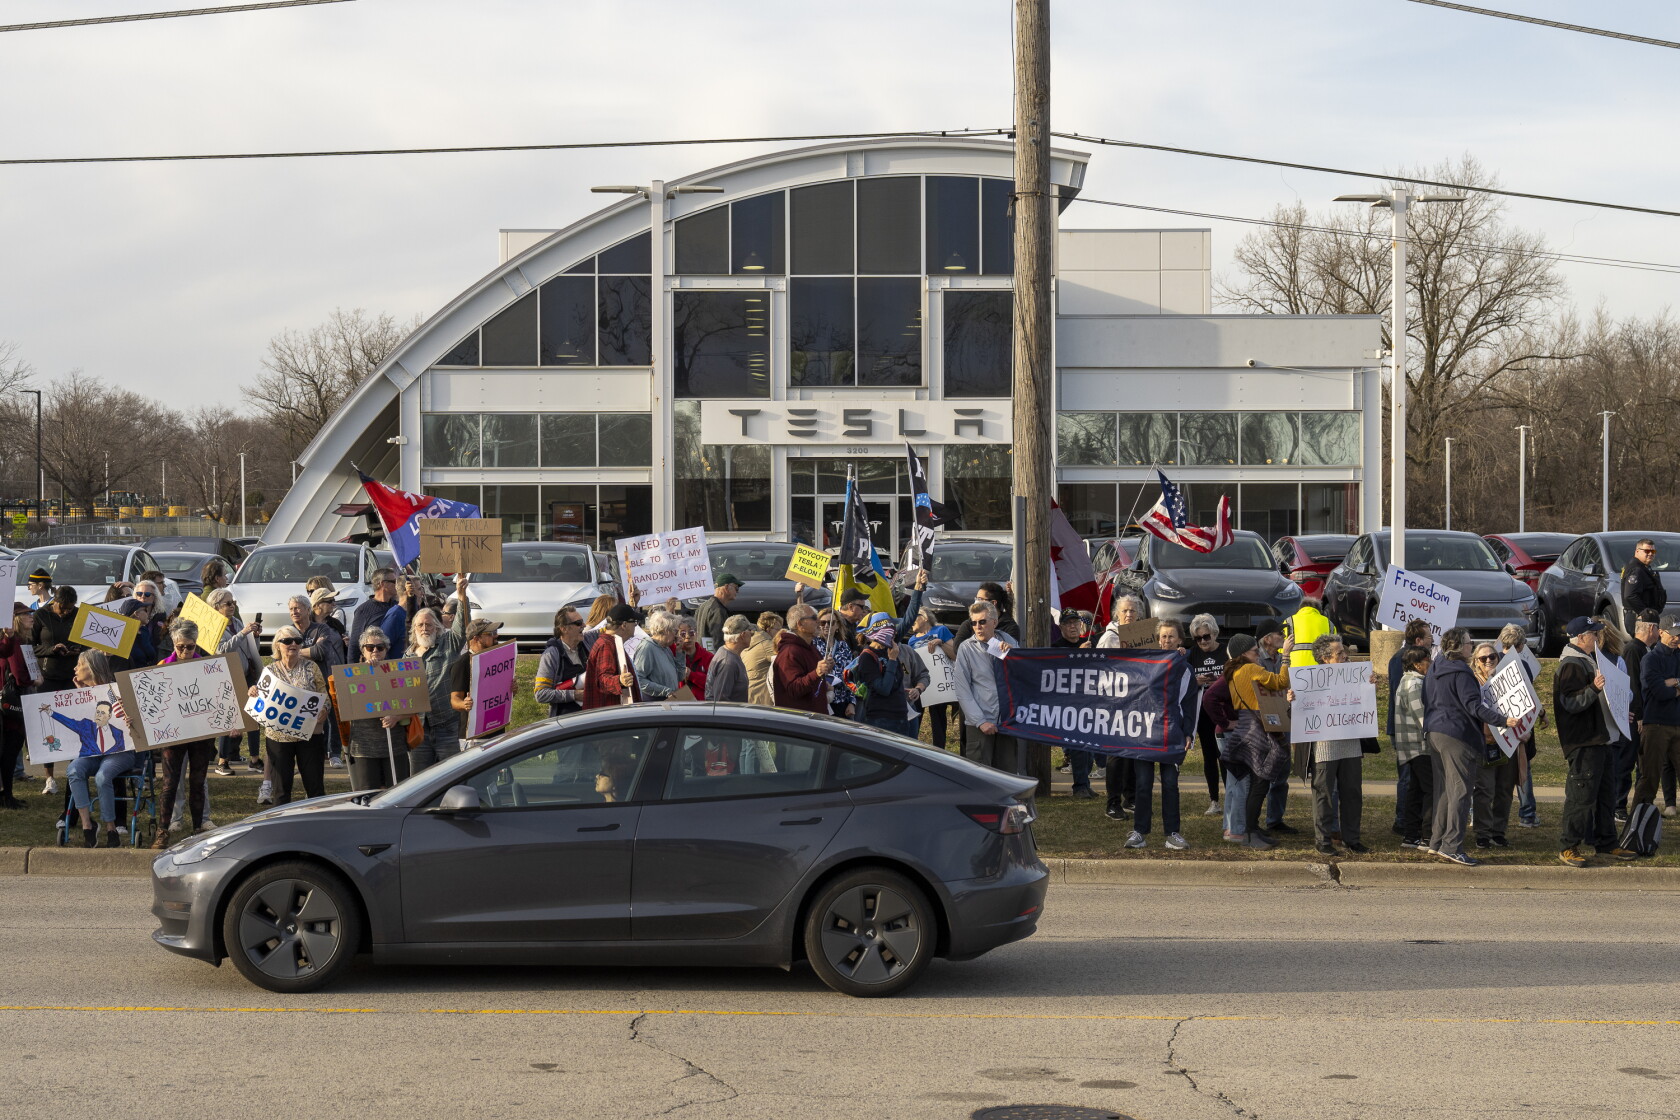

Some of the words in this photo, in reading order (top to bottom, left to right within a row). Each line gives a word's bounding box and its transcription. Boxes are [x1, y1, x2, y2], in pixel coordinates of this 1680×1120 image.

[728, 408, 984, 436] TESLA
[428, 520, 449, 531] MAKE
[454, 520, 489, 532] AMERICA
[434, 535, 492, 551] THINK
[633, 539, 660, 551] NEED
[665, 537, 680, 547] TO
[684, 534, 698, 544] BE
[436, 552, 483, 566] AGAIN
[629, 558, 645, 568] BLE
[650, 555, 661, 563] TO
[667, 551, 685, 560] TELL
[688, 548, 701, 557] MY
[797, 547, 829, 563] BOYCOTT
[632, 569, 678, 583] RANDSON
[693, 564, 707, 572] DID
[639, 589, 648, 597] OT
[655, 585, 672, 594] STAY
[678, 579, 706, 591] SILENT
[1394, 569, 1450, 605] Freedom
[1410, 598, 1436, 613] over
[89, 621, 119, 638] ELON
[1392, 602, 1442, 637] Fassm
[380, 660, 421, 674] WHERE
[484, 657, 515, 678] ABORT
[136, 672, 152, 699] STAY
[348, 683, 367, 694] DO
[374, 680, 380, 691] I
[390, 676, 421, 688] EVEN
[1040, 668, 1129, 698] DEFEND
[1294, 666, 1334, 692] STOP
[1335, 666, 1368, 685] MUSK
[54, 692, 73, 702] STOP
[77, 690, 91, 698] THE
[55, 700, 72, 708] NAZI
[75, 695, 97, 705] COUP!
[141, 697, 150, 712] OUT
[148, 684, 157, 696] OF
[148, 703, 159, 718] MY
[154, 681, 167, 704] DATA
[214, 702, 226, 726] STOP
[222, 682, 233, 701] THE
[271, 688, 298, 710] NO
[482, 692, 509, 711] TESLA
[178, 698, 216, 715] MUSK
[253, 697, 306, 730] DOGE
[224, 705, 236, 730] CHAOS
[1015, 703, 1156, 739] DEMOCRACY
[1304, 714, 1322, 732] NO
[1326, 710, 1375, 728] OLIGARCHY
